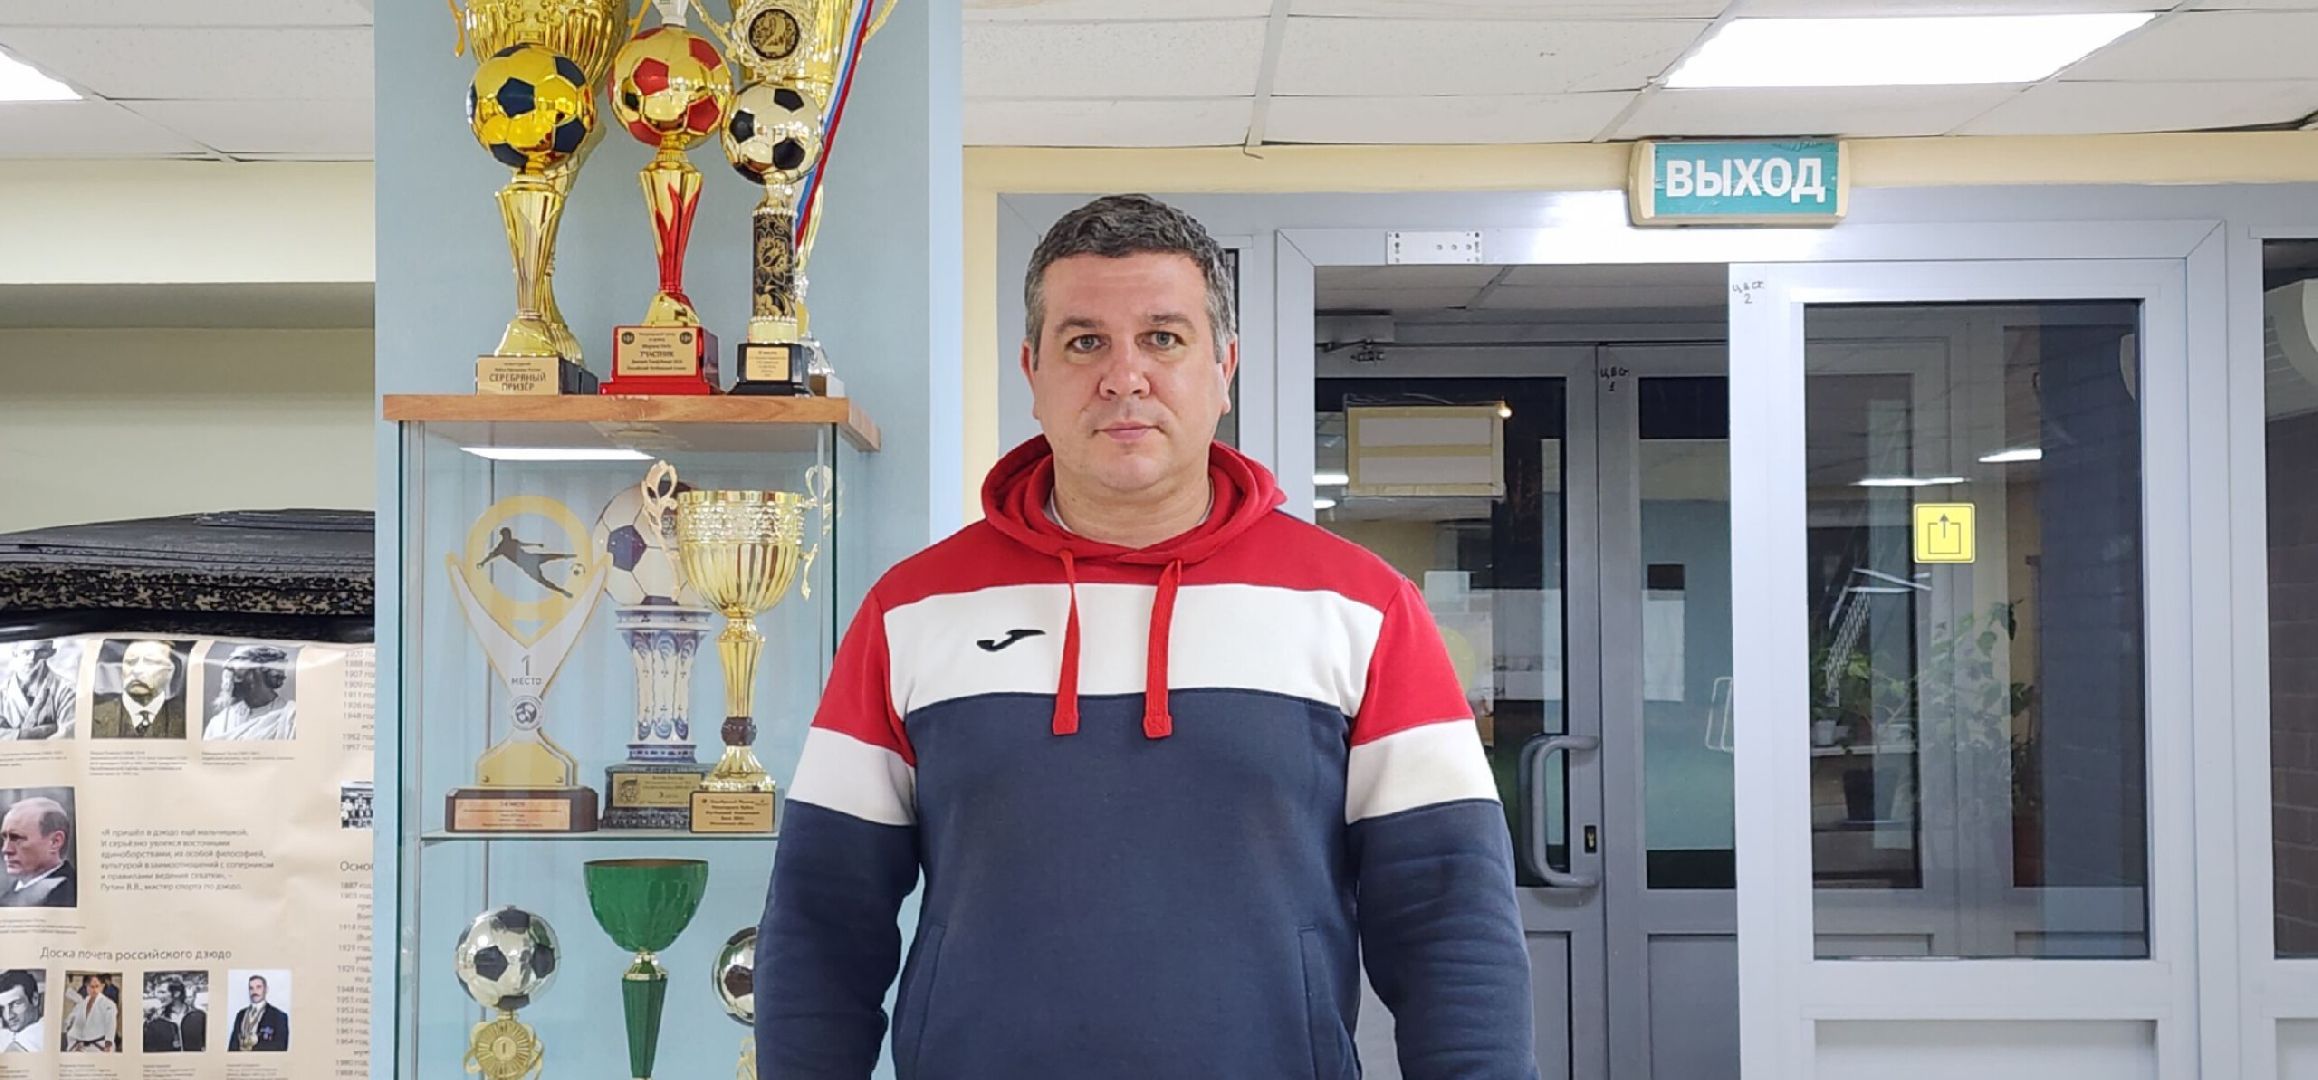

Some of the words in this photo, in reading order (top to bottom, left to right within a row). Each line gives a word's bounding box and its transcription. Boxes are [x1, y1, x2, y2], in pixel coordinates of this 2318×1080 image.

[1666, 157, 1826, 203] ВЫХОД
[488, 371, 546, 383] СЕРЕБРЯНЫЙ
[521, 654, 530, 676] 1
[511, 677, 542, 685] МЕСТО
[40, 946, 76, 959] Доска
[115, 948, 192, 962] российского
[195, 949, 232, 961] дзюдо
